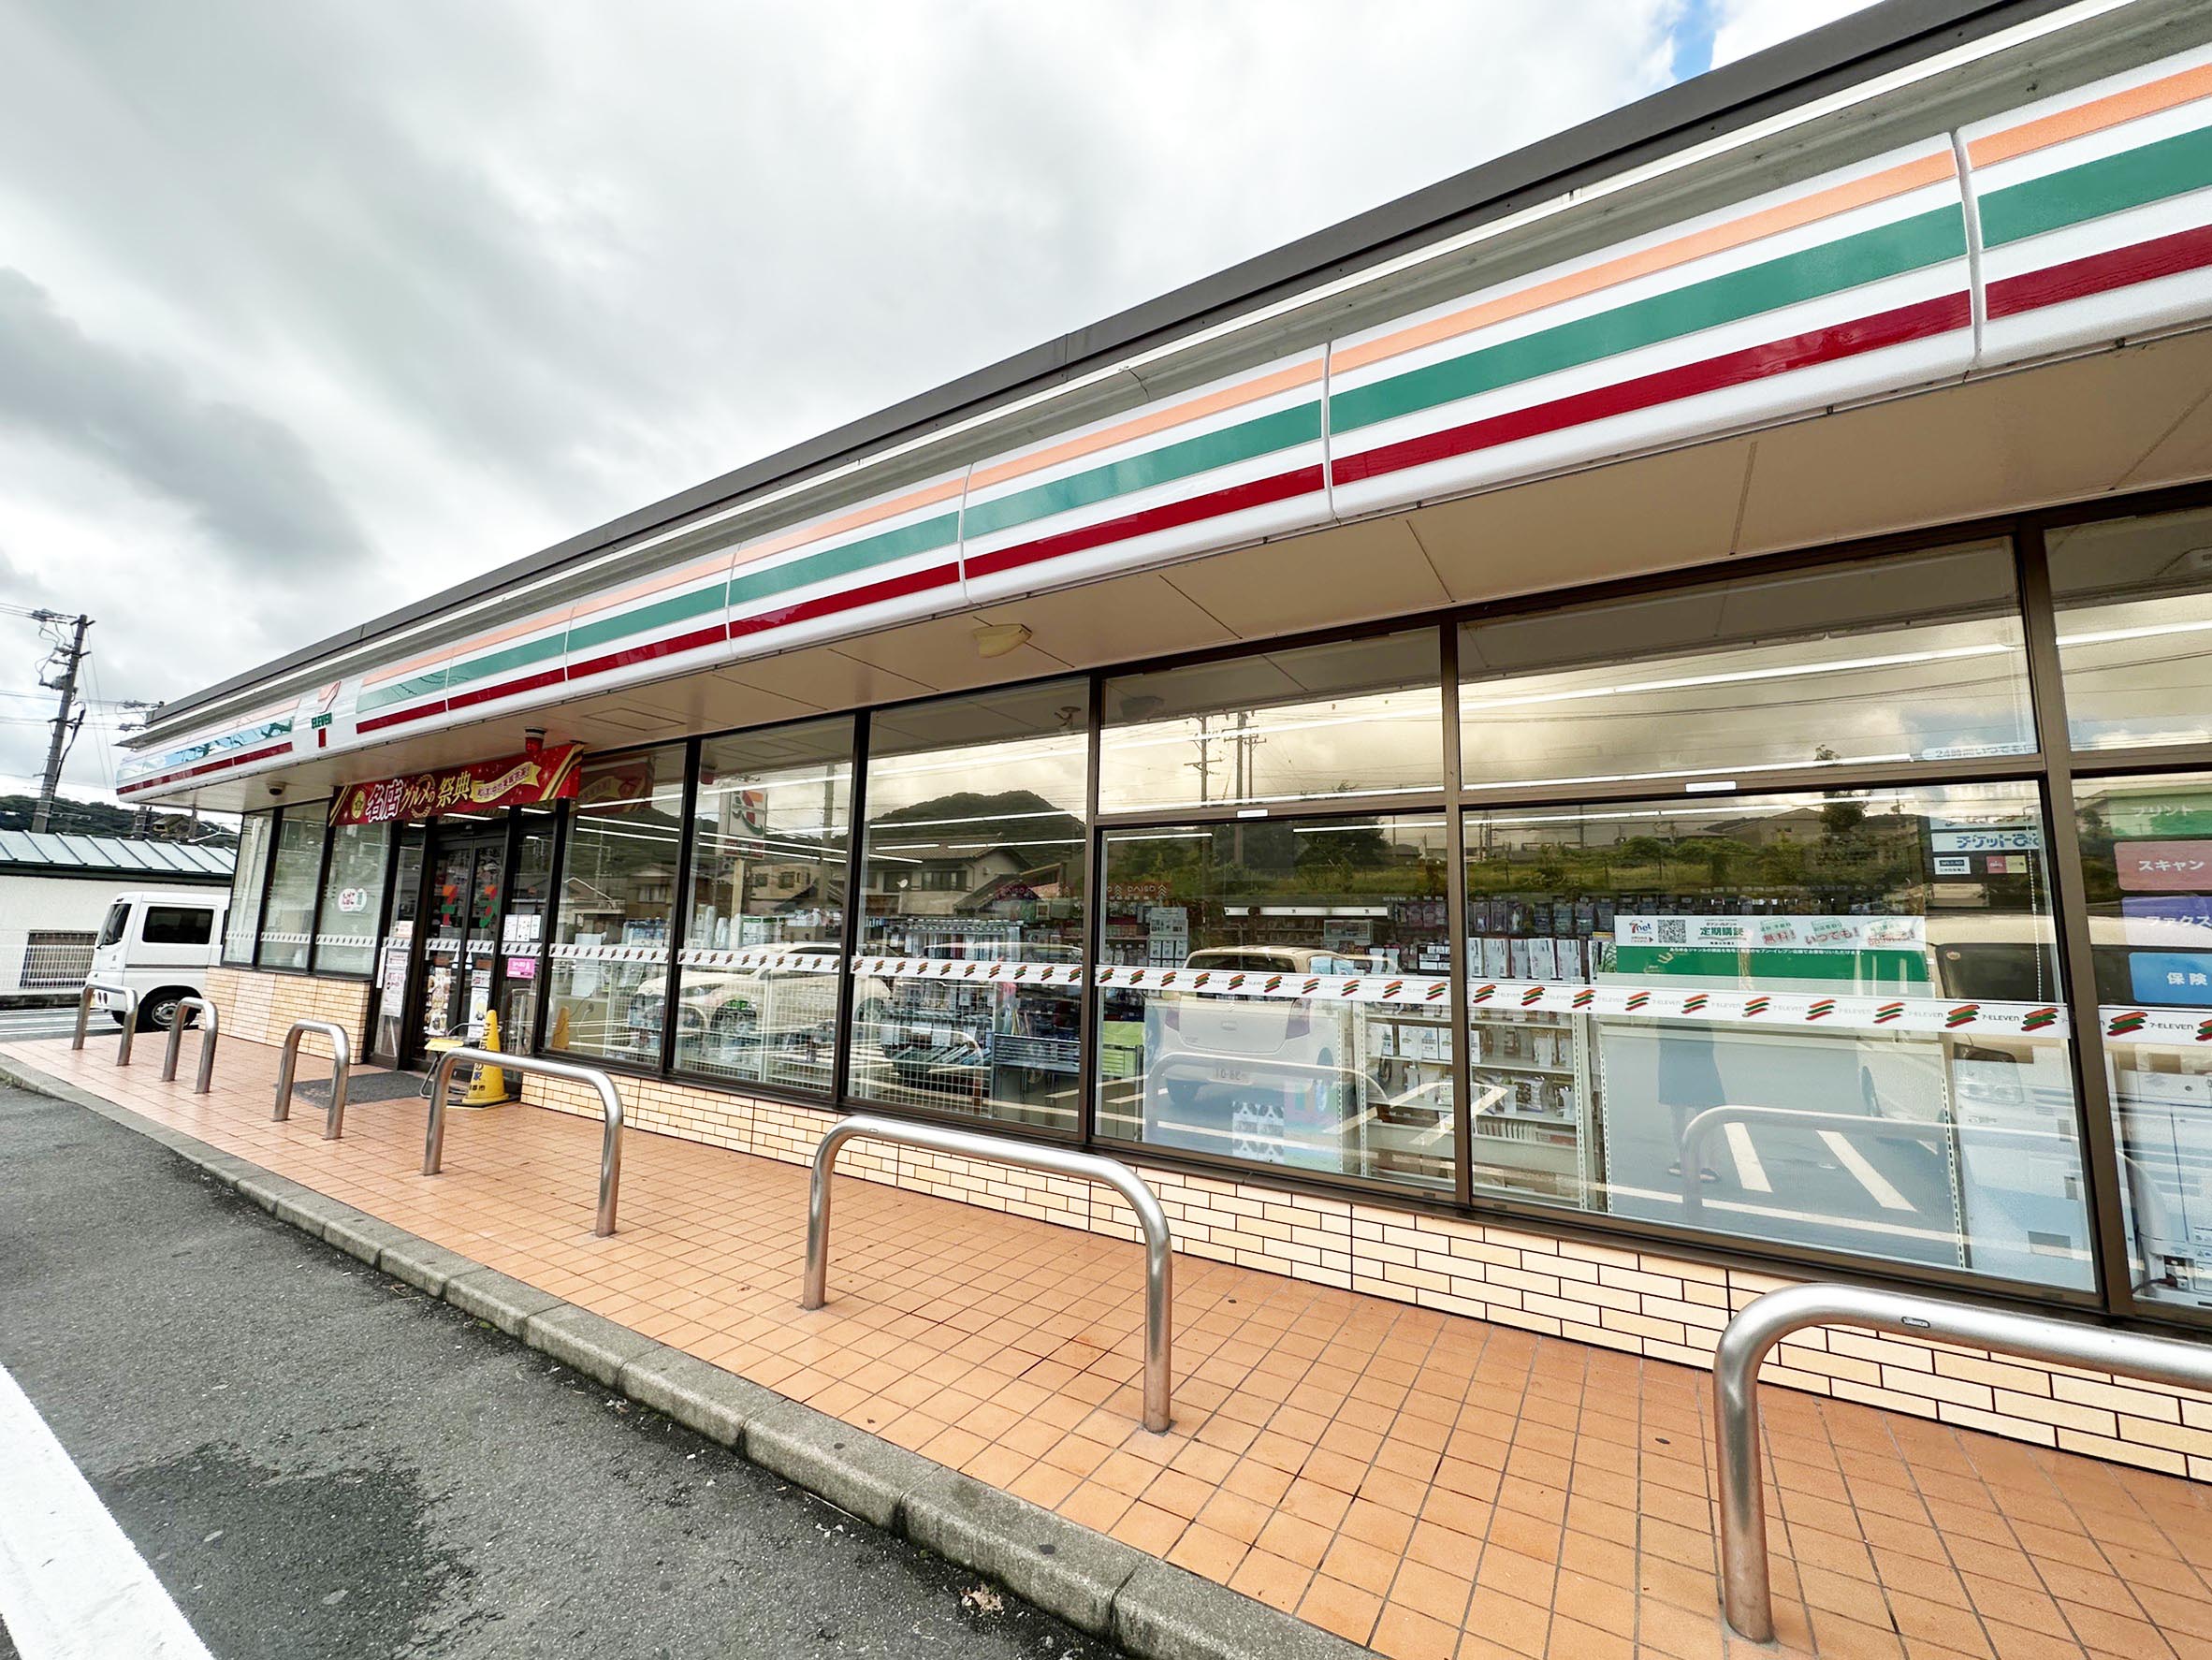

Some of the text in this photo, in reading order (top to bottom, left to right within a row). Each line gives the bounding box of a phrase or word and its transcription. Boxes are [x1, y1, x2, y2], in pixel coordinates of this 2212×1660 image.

[2138, 860, 2205, 871] スキャン
[2146, 915, 2212, 927] ファクス
[1699, 927, 1744, 937] 定期購読
[2167, 972, 2208, 985] 保険
